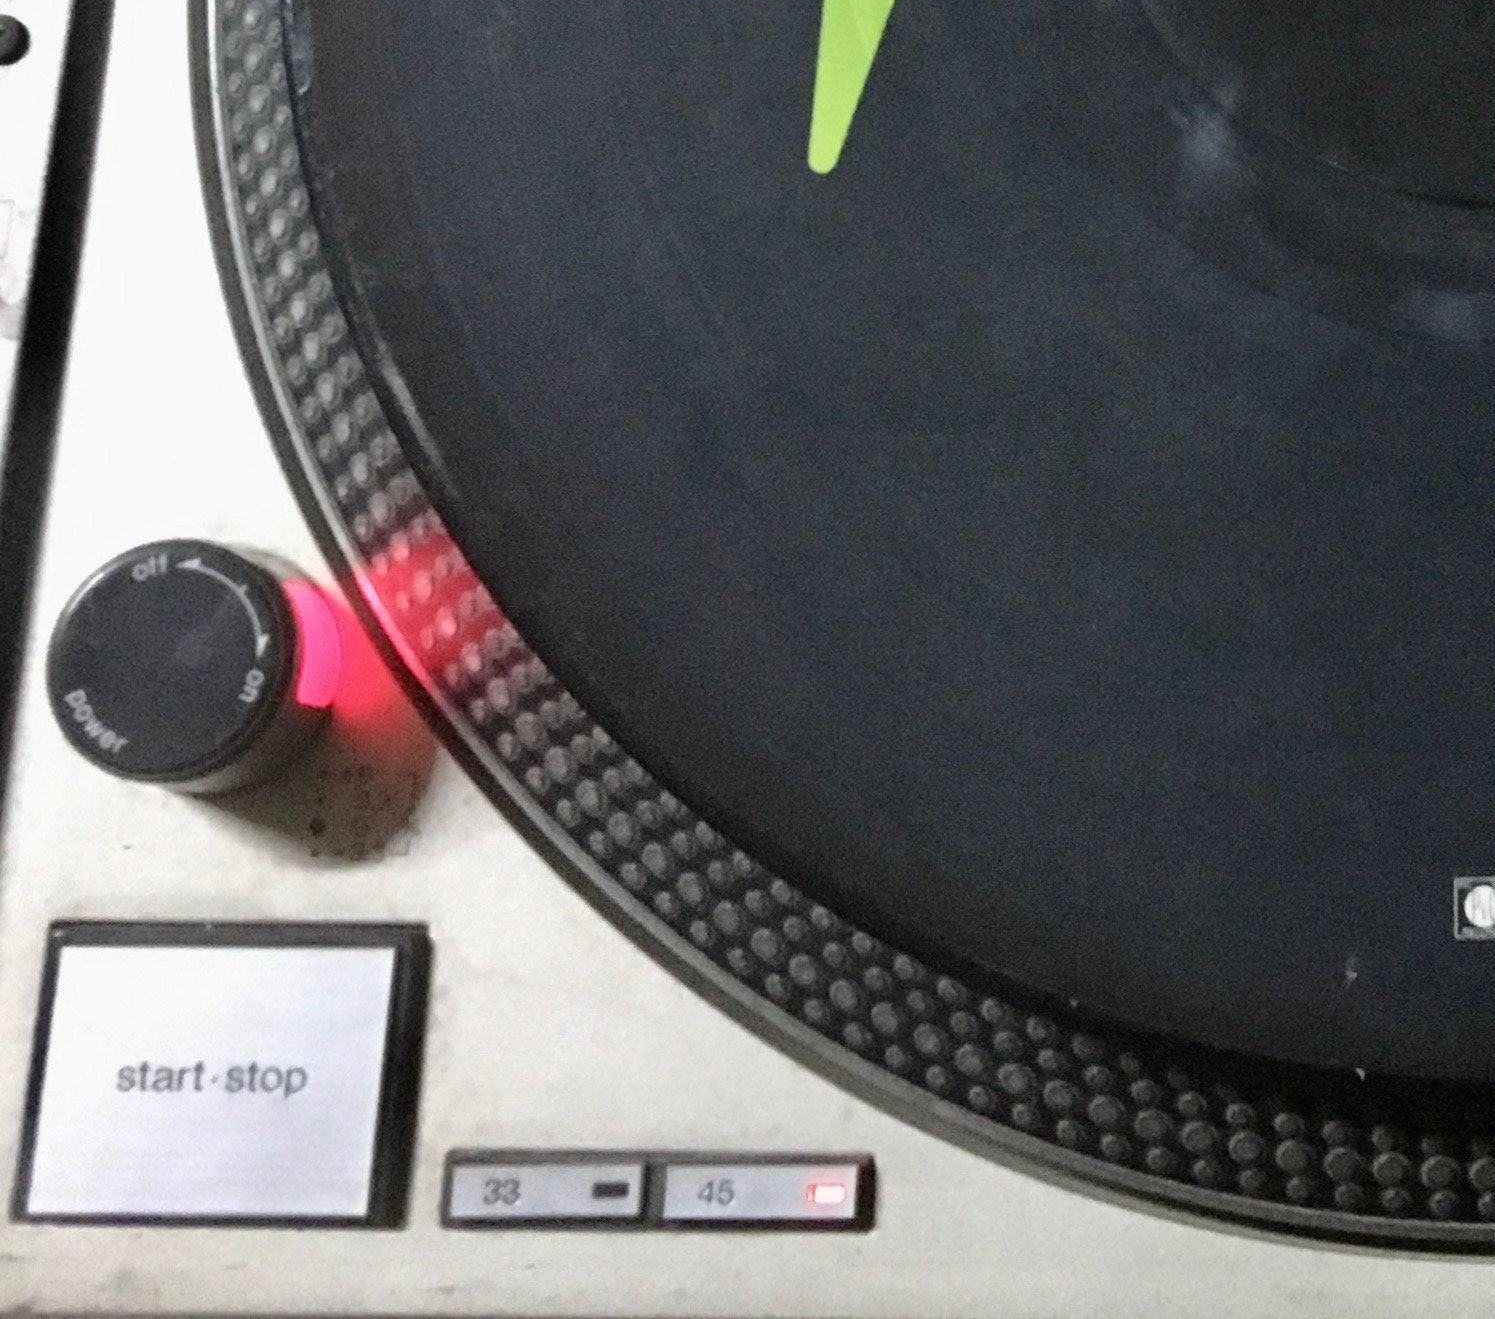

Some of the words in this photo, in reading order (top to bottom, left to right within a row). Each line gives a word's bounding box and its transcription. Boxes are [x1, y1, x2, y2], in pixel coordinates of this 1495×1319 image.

[238, 668, 266, 703] on
[483, 1179, 521, 1205] 33
[698, 1179, 735, 1206] 45
